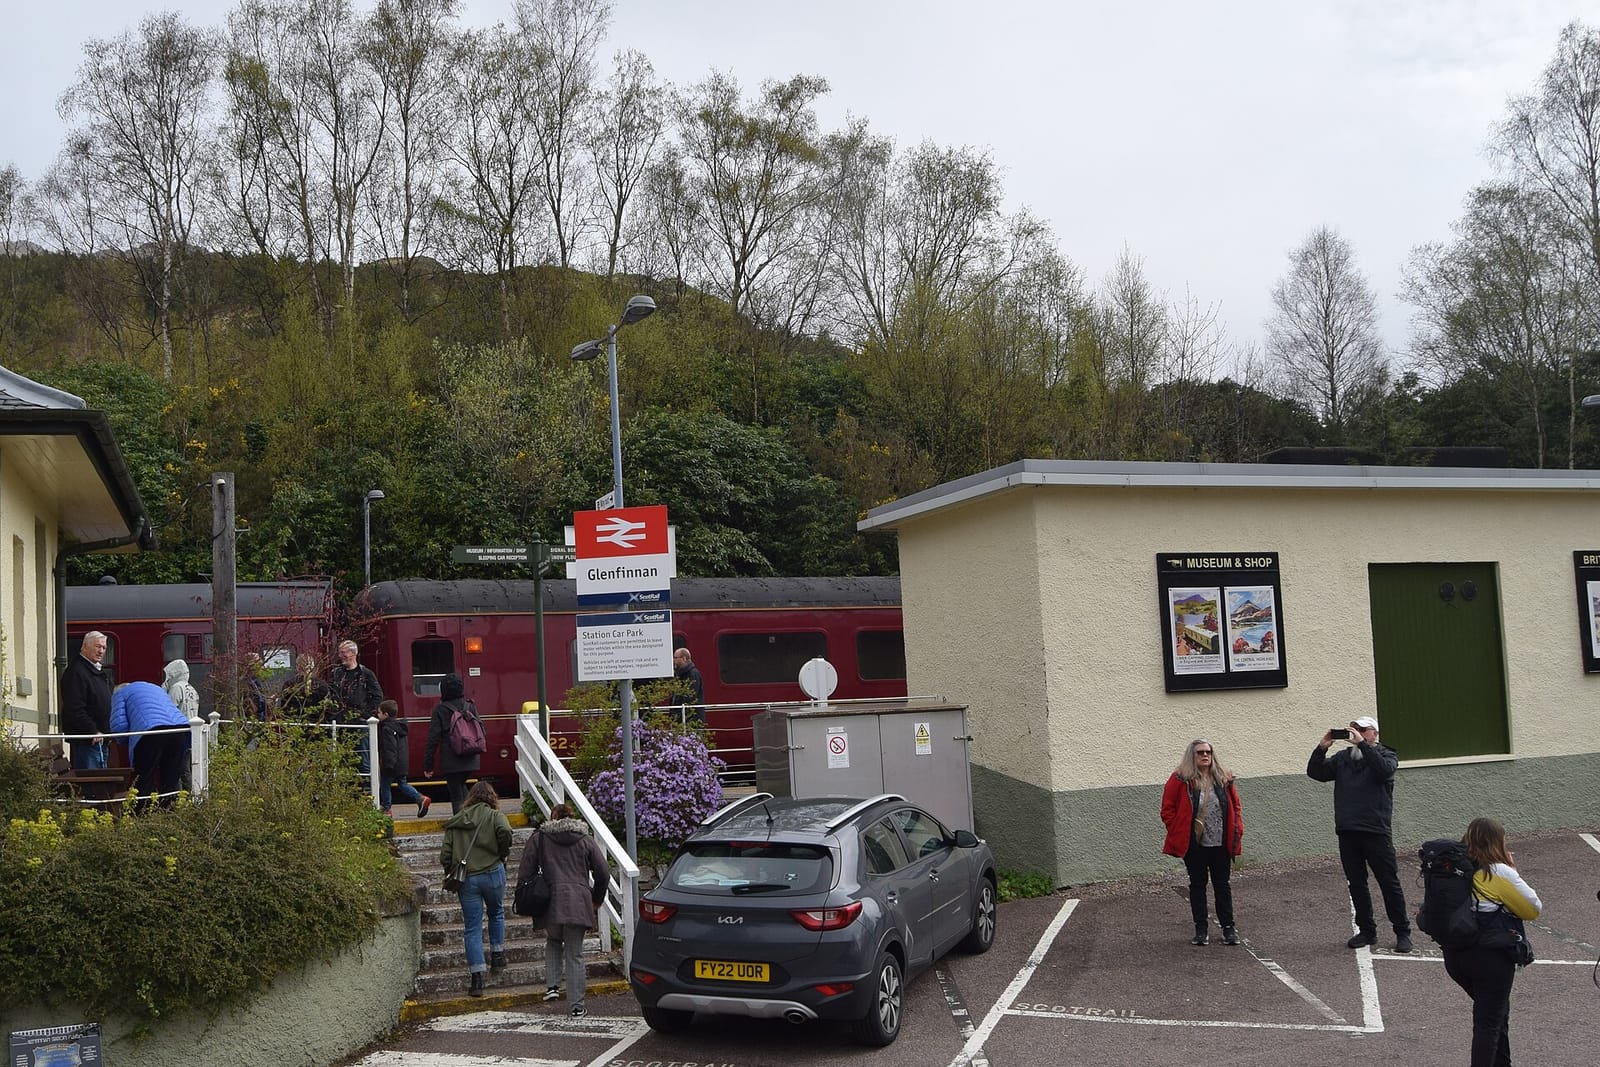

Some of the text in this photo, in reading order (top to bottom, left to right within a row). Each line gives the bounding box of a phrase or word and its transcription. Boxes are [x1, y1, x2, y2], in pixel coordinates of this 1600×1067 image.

[1186, 557, 1273, 568] MUSEUM & SHOP
[587, 566, 658, 581] Glenfinnan
[582, 628, 644, 640] Station Car Park
[718, 916, 743, 924] KIA
[701, 962, 763, 978] FY22 UOR
[1015, 1002, 1143, 1018] SCOTRAIL
